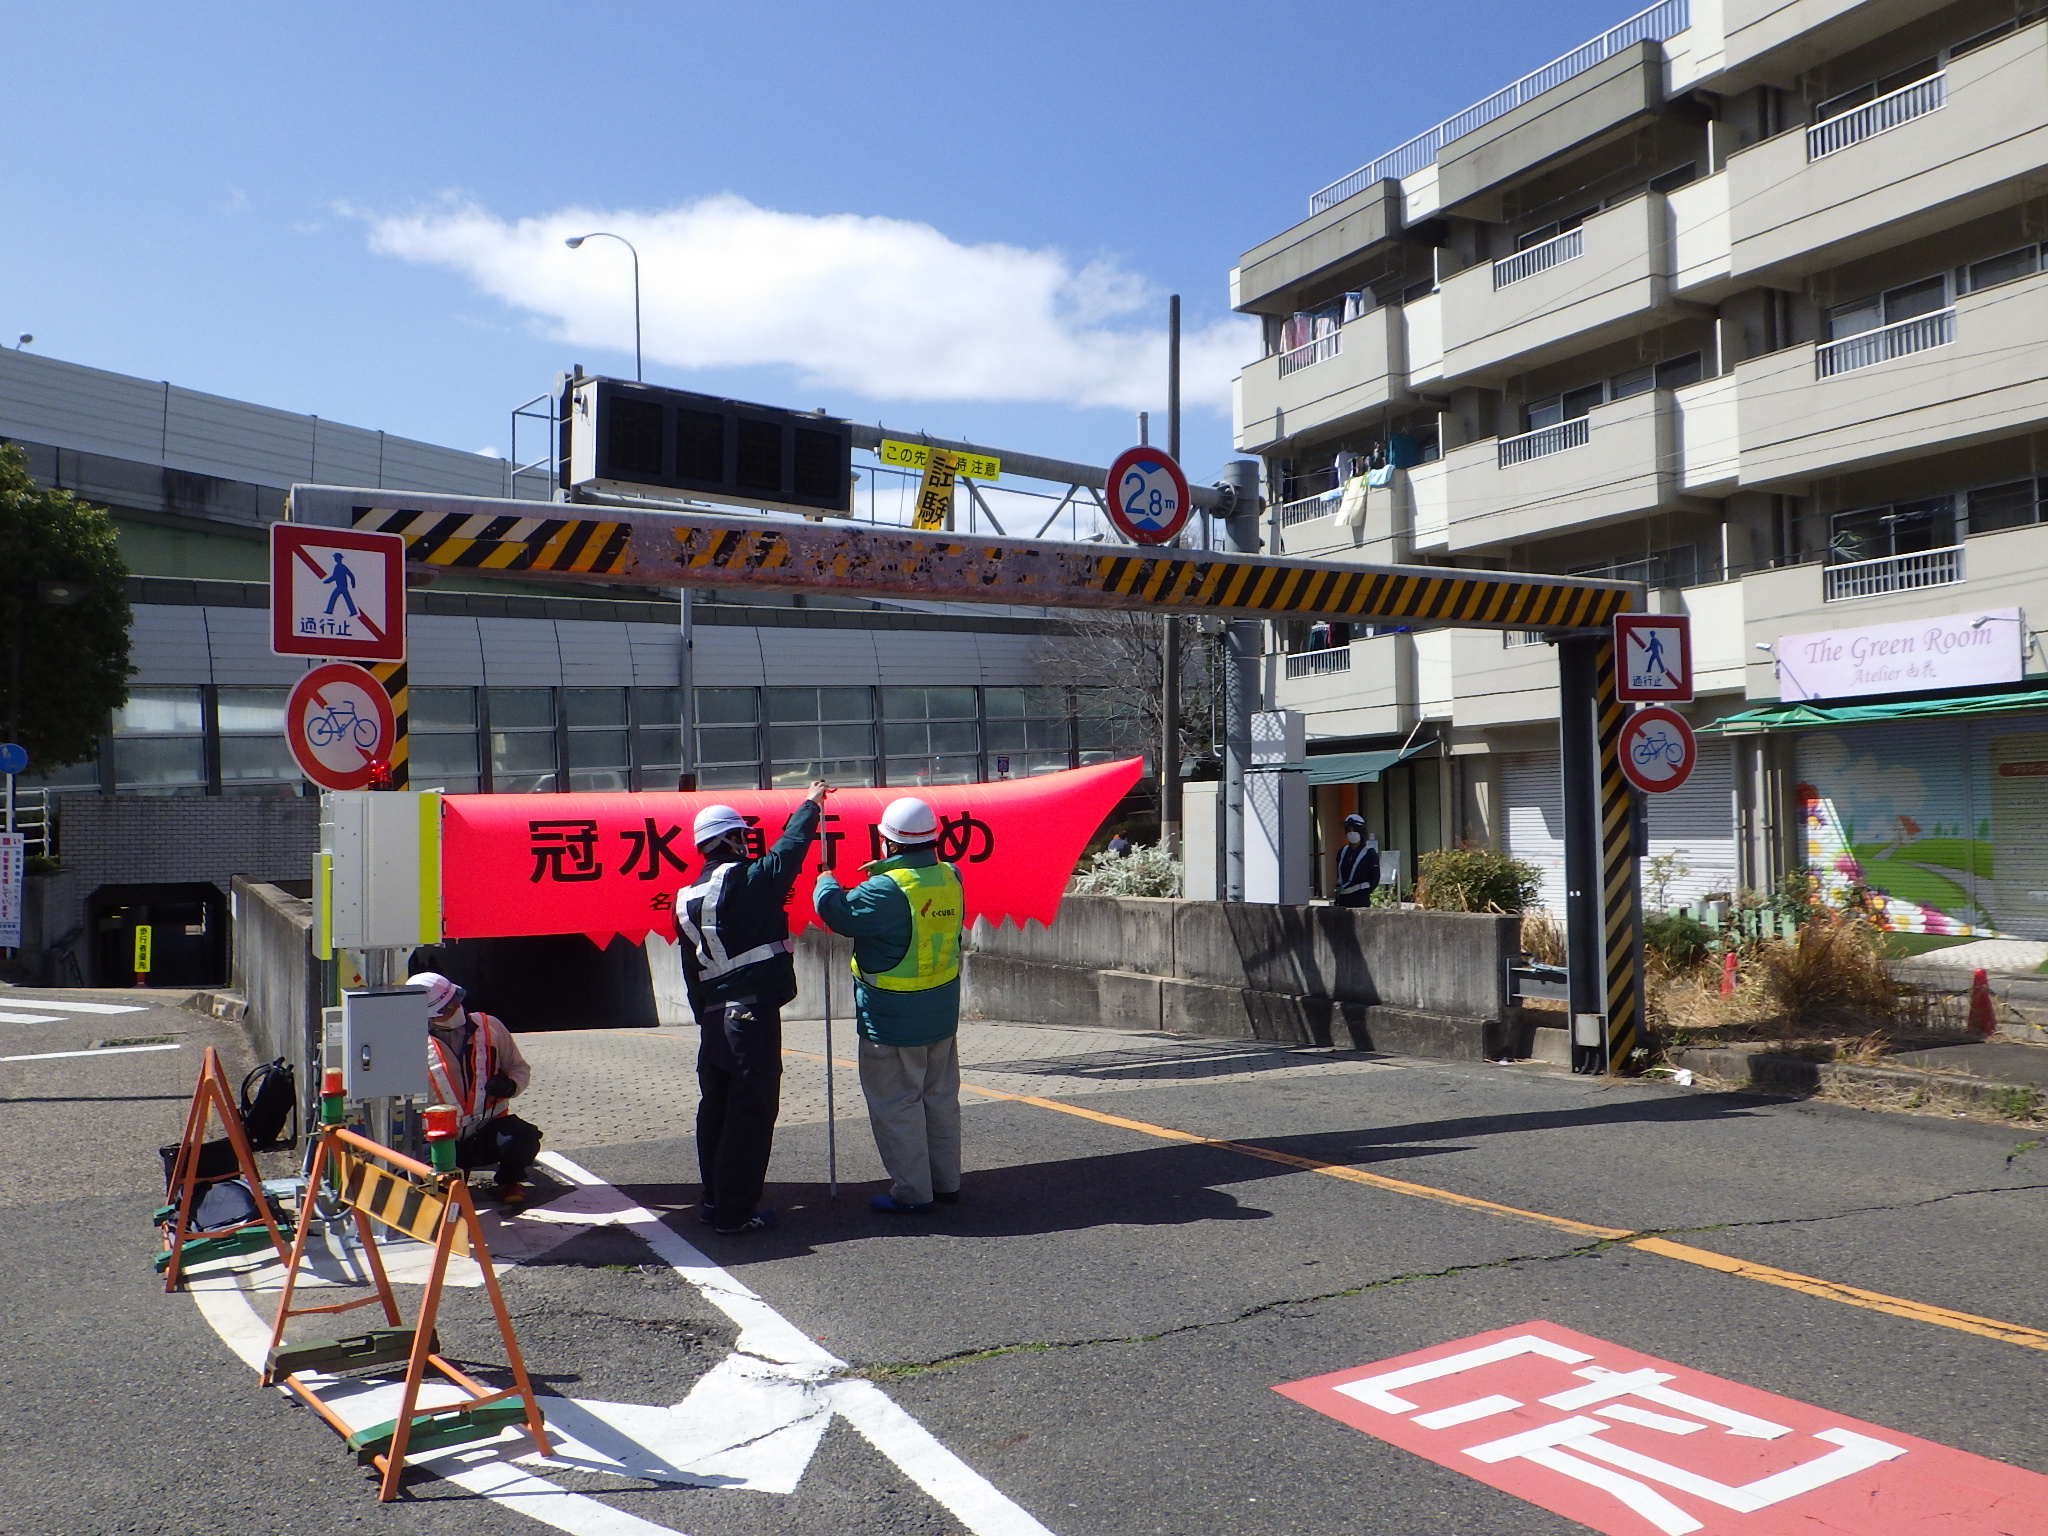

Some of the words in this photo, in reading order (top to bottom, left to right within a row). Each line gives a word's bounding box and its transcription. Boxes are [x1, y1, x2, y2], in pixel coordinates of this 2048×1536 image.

[300, 617, 352, 636] 通行止
[1805, 637, 1843, 664] The
[1851, 636, 1915, 667] Green
[1923, 627, 1992, 655] Room
[1633, 675, 1663, 687] 通行止
[1850, 664, 1903, 687] Atelier
